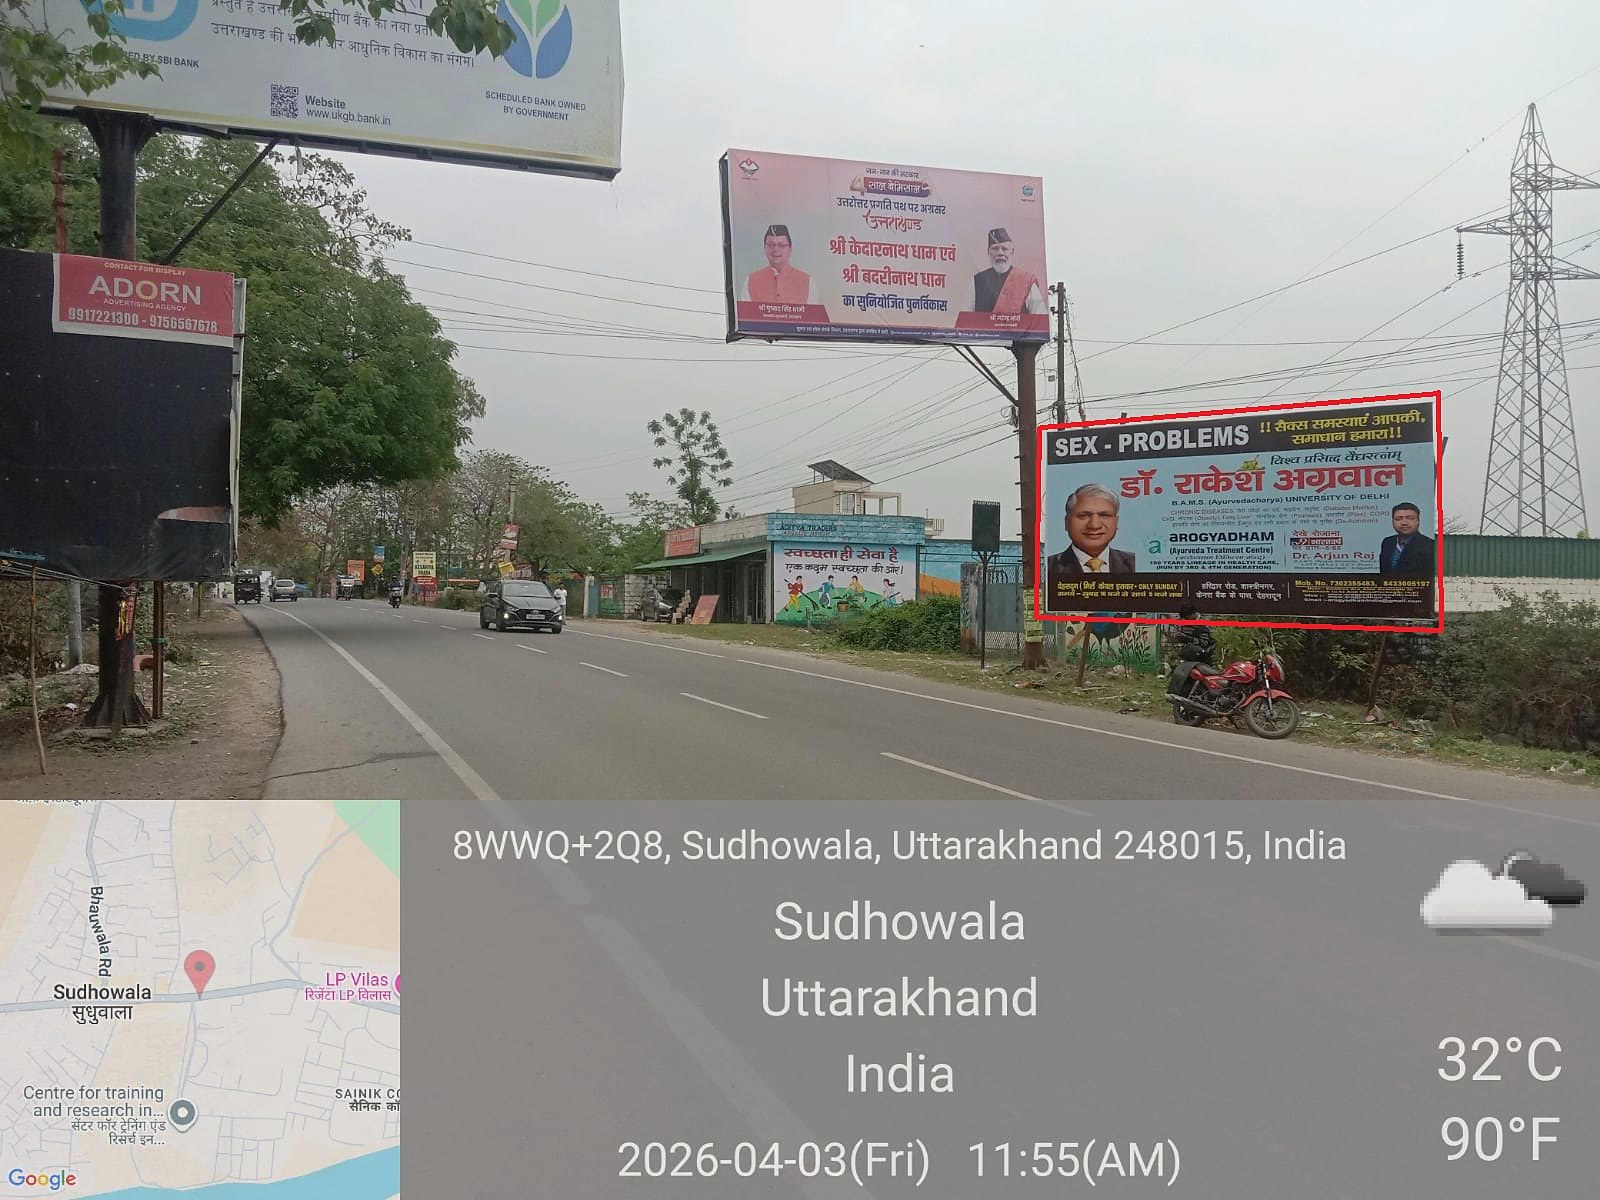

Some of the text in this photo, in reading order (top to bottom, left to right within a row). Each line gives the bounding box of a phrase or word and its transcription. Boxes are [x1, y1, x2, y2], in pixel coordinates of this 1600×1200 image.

[210, 22, 267, 40] उत्तराखण्ड
[269, 27, 284, 42] की
[374, 18, 388, 30] का
[390, 20, 412, 33] नया
[349, 40, 390, 58] आधुनिक
[394, 43, 428, 61] विकास
[430, 52, 444, 64] का
[157, 55, 173, 65] SBI
[174, 57, 200, 68] BANK
[305, 95, 347, 110] Website
[485, 90, 586, 111] SCHEDULED BANK OWNED
[306, 109, 391, 127] www.ukgb.bank.in
[503, 105, 569, 121] BY GOVERNMENT
[869, 197, 892, 211] प्रगति
[893, 201, 907, 213] पथ
[908, 203, 919, 214] पर
[830, 235, 957, 261] श्री केदारनाथ धाम एवं
[104, 262, 186, 277] CONTACT FOR DISPLAY
[843, 263, 947, 289] श्री बदरीनाथ धाम
[88, 275, 201, 305] ADORN
[103, 297, 186, 312] ADVERTISING AGENCY
[842, 292, 948, 314] का सुनियोजित पुनर्विकास
[68, 307, 139, 326] 9917221300
[150, 314, 218, 334] 9756567678
[1311, 413, 1370, 430] समस्याएं
[1055, 436, 1098, 457] SEX
[1118, 424, 1249, 453] PROBLEMS
[1292, 432, 1346, 446] समाधान
[1270, 453, 1301, 466] विश्व
[1120, 464, 1406, 499] डॉ. राकेश अग्रवाल
[1208, 496, 1283, 506] (Ayurvedacharya)
[1285, 494, 1342, 503] UNIVERSITY
[1343, 493, 1358, 501] OF
[1359, 492, 1390, 500] DELHI
[784, 545, 900, 563] स्वच्छता ही सेवा है
[1169, 545, 1274, 556] (Ayurveda Treatment Centre)
[1292, 551, 1375, 561] Dr. Arjun Raj
[785, 563, 803, 574] एक
[804, 565, 828, 575] कदम
[831, 565, 868, 575] स्वच्छता
[871, 562, 884, 574] की
[1138, 582, 1153, 590] ONLY
[1154, 582, 1178, 590] SUNDAY
